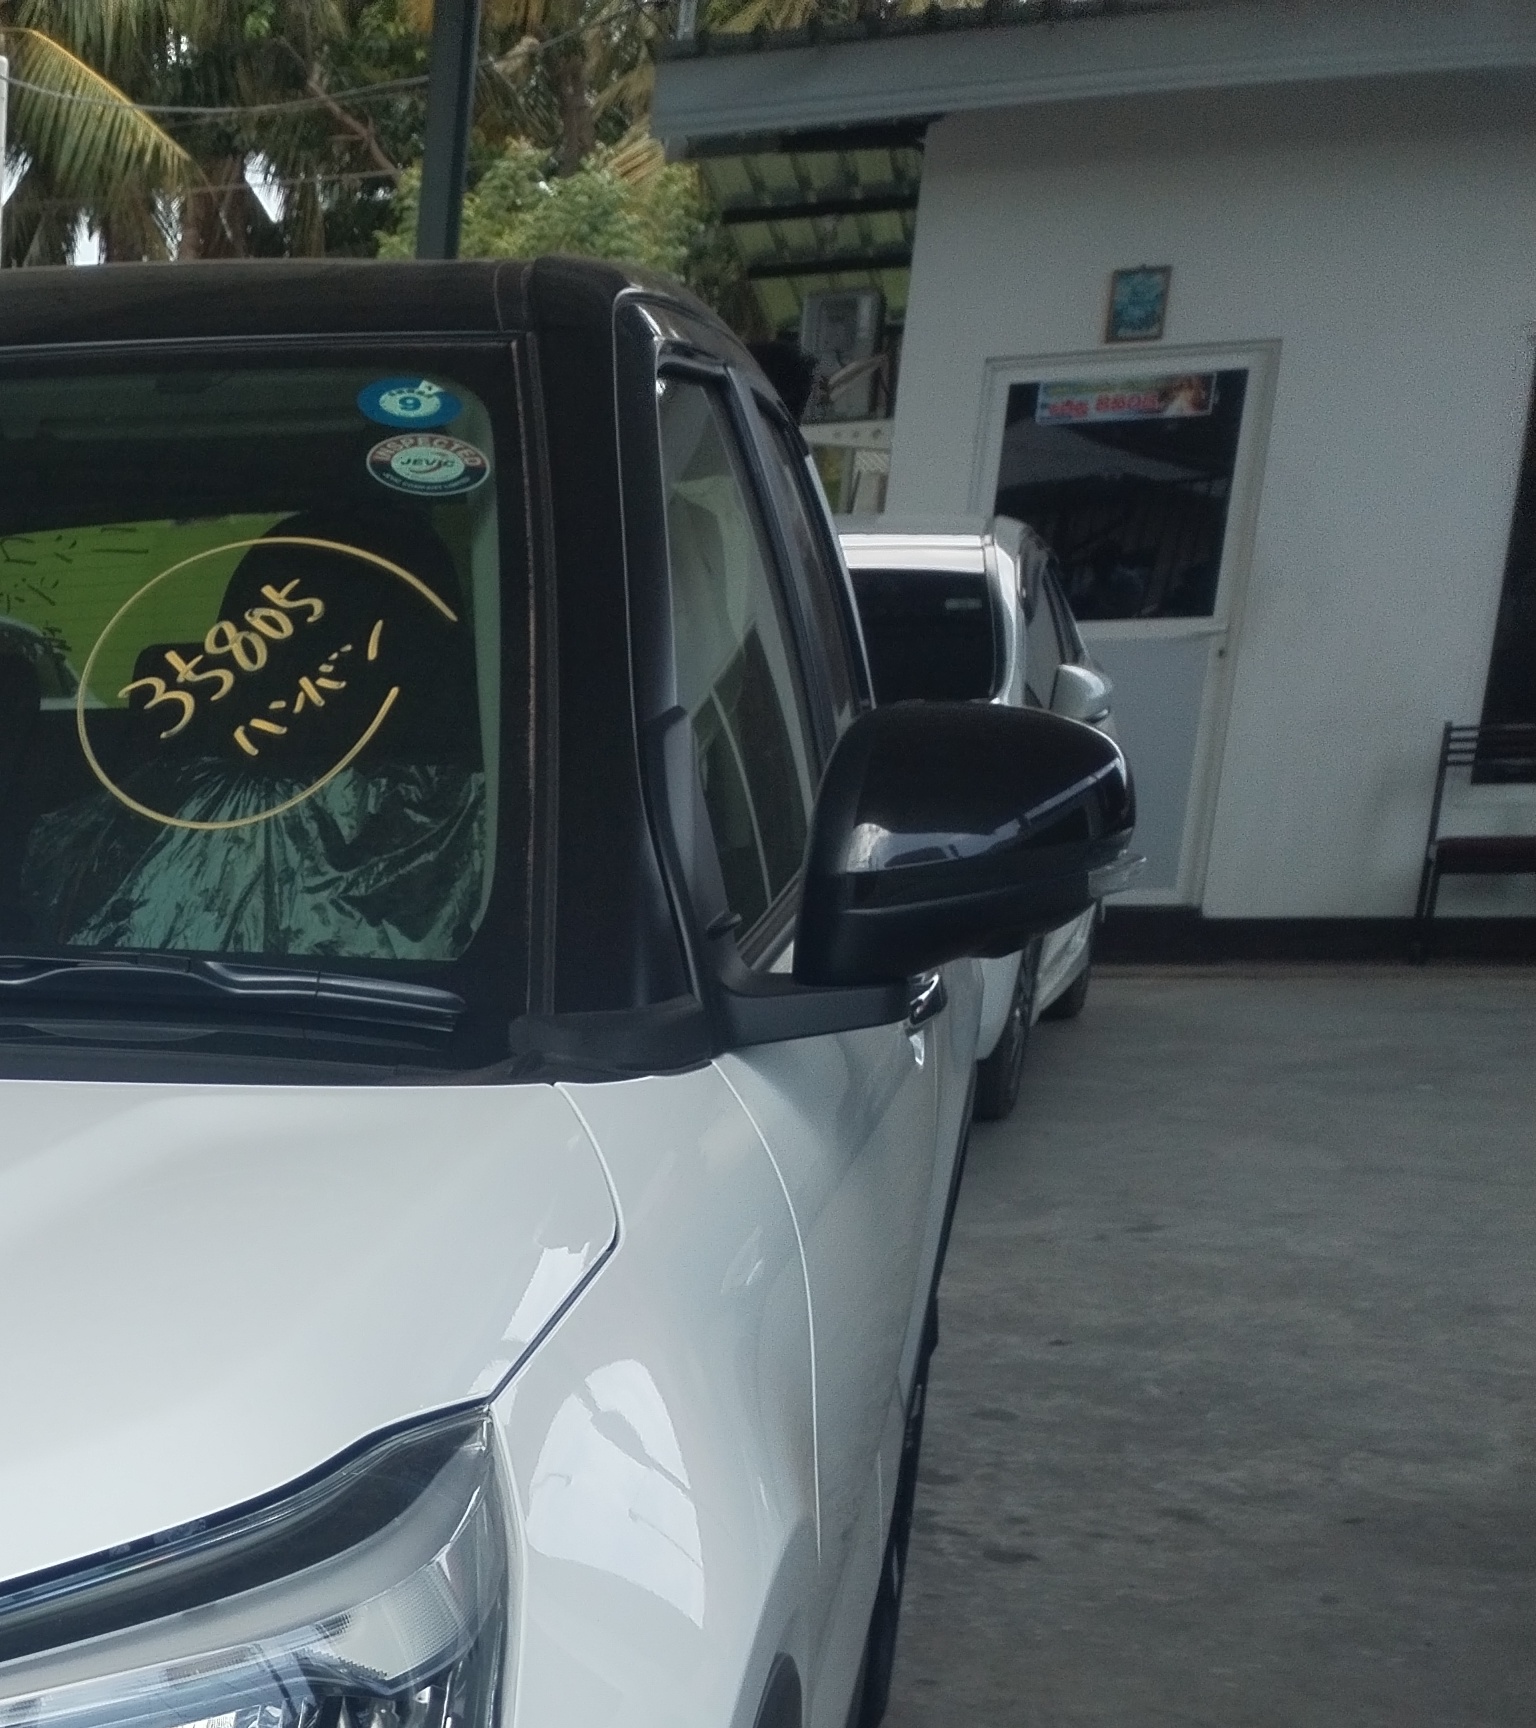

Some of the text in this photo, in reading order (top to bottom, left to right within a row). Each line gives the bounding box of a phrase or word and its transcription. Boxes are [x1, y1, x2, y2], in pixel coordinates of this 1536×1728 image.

[371, 436, 482, 467] INSPECTED
[400, 458, 456, 467] JEVIC
[117, 578, 325, 740] 35805
